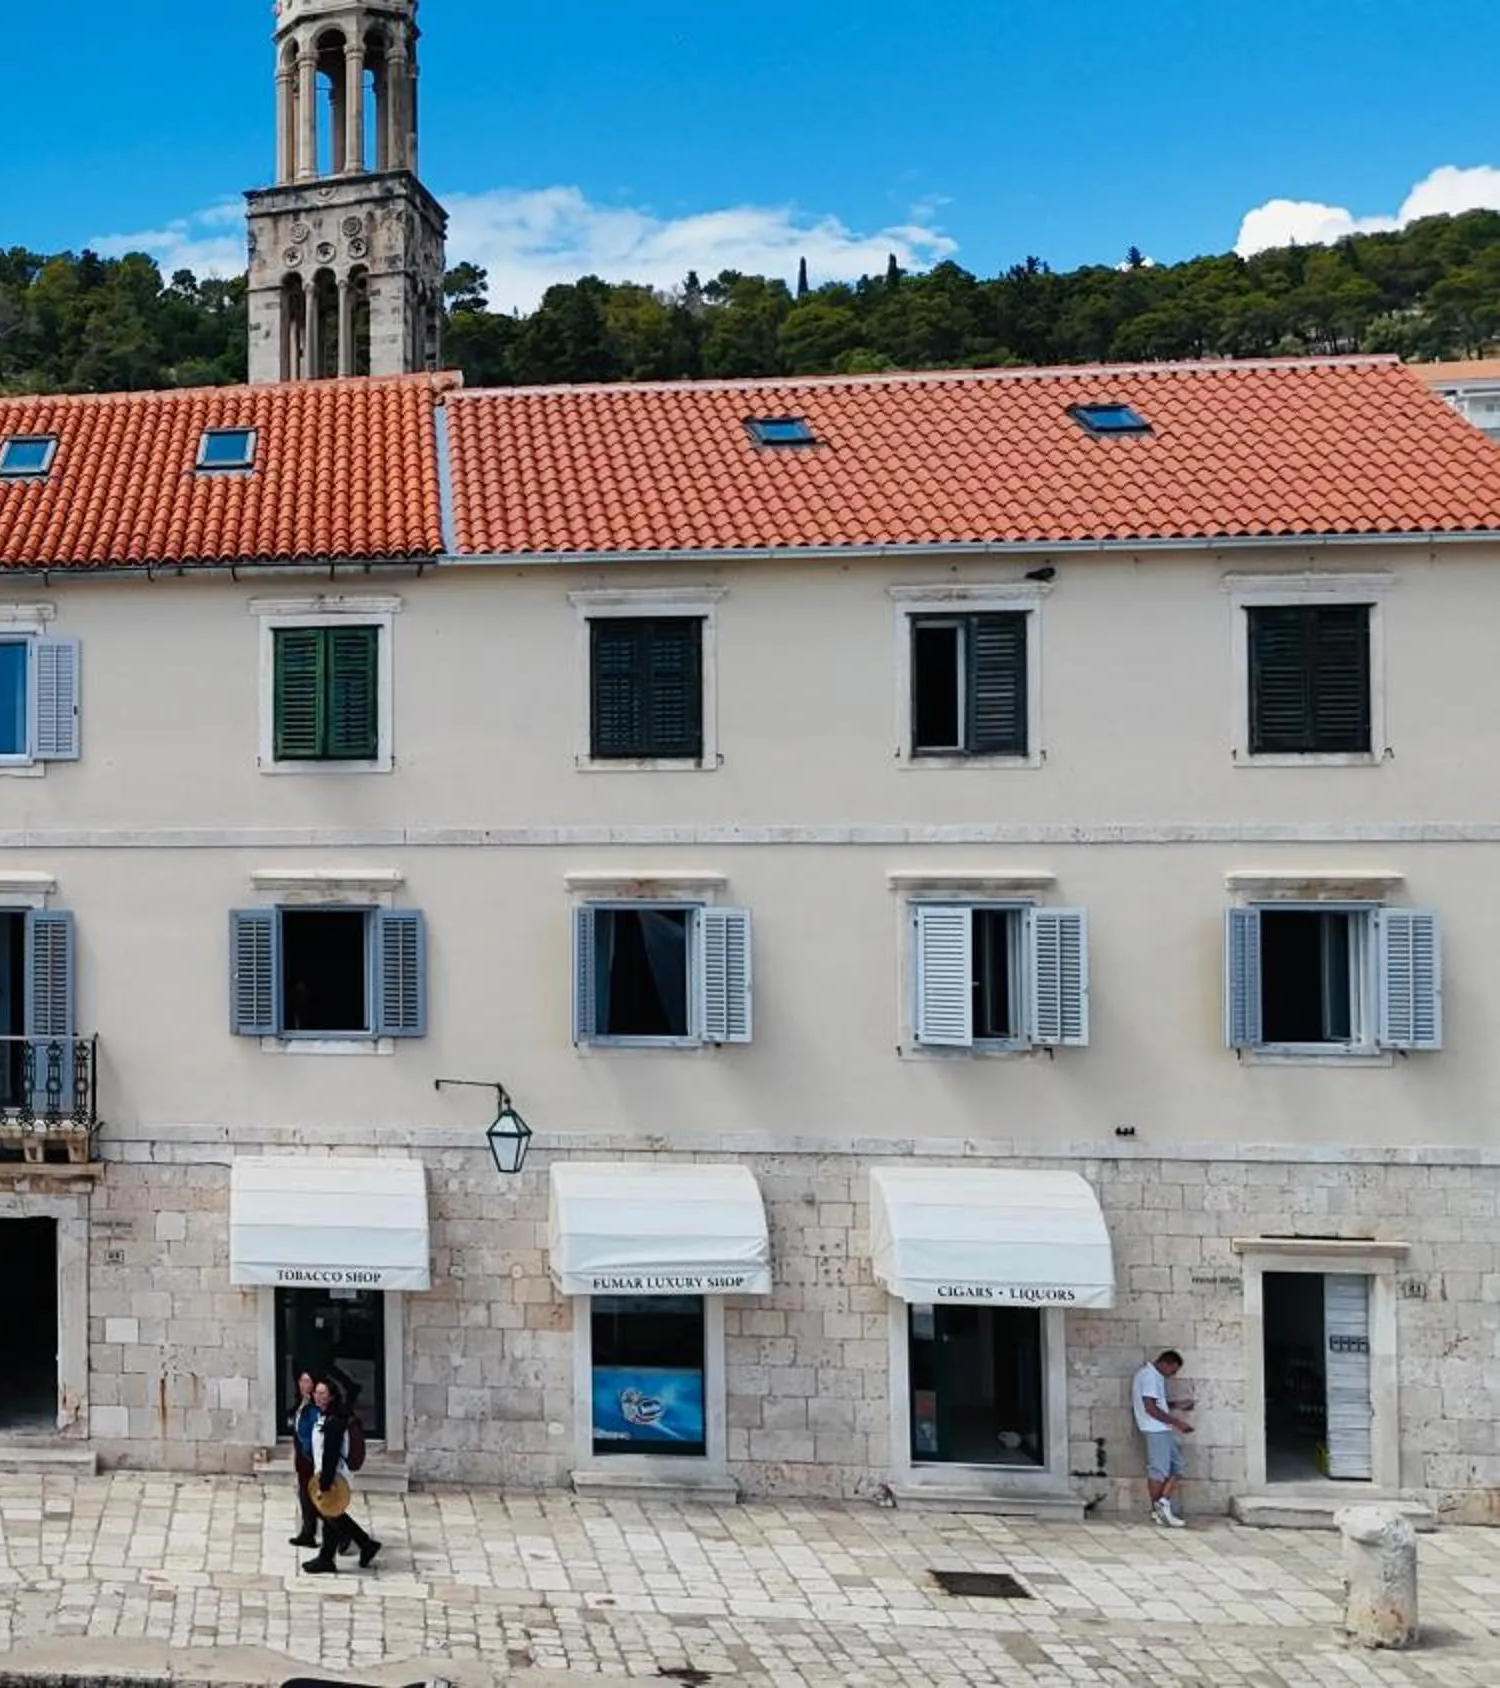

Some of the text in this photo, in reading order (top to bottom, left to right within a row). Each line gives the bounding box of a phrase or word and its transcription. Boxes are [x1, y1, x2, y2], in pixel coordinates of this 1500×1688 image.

[276, 1269, 382, 1283] TOBACCO SHOP
[593, 1276, 744, 1289] FUMAR LUXURY SHOP
[937, 1285, 1076, 1302] CIGARS LIQUORS
